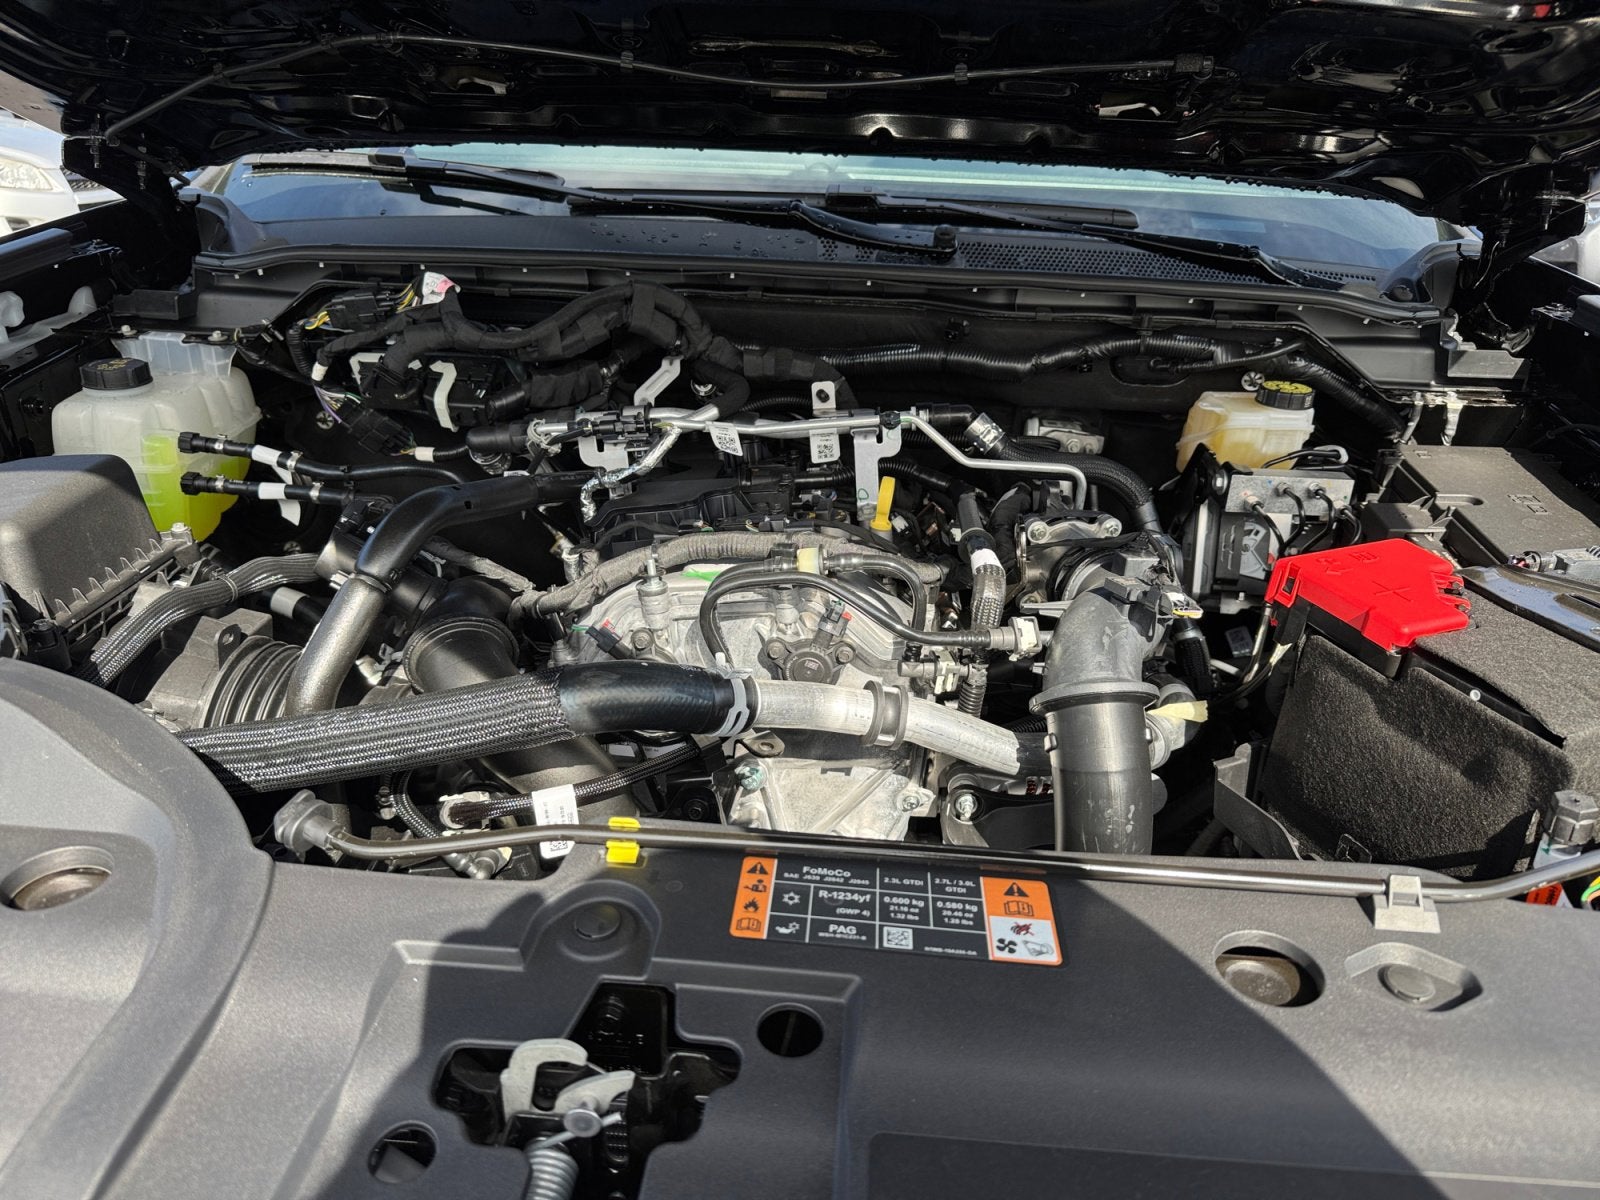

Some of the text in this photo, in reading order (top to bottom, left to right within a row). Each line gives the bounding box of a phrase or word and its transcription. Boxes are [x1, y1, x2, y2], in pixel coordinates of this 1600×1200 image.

[803, 866, 851, 877] FoMoCo
[902, 878, 924, 886] GTDI
[818, 889, 871, 904] R-1234yf
[883, 896, 925, 907] 0.600 kg
[861, 909, 871, 917] 4)
[965, 903, 978, 912] kg
[828, 924, 857, 935] PAG
